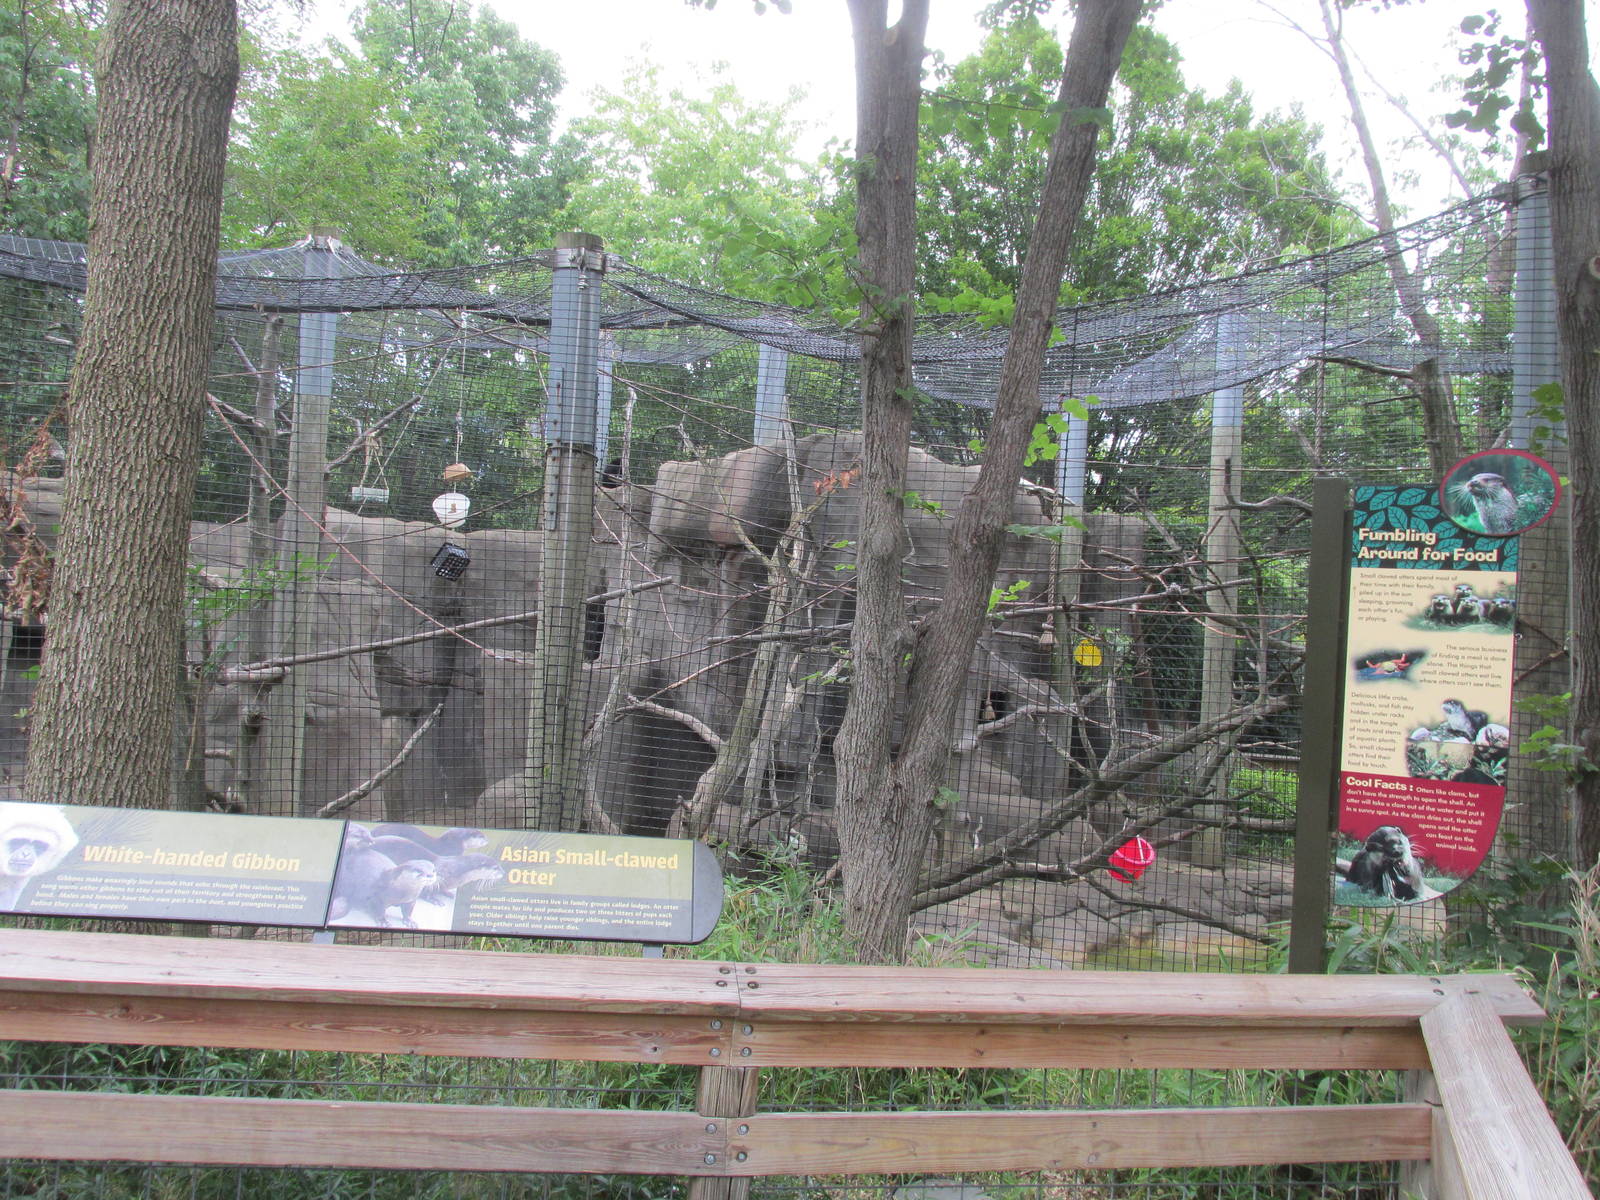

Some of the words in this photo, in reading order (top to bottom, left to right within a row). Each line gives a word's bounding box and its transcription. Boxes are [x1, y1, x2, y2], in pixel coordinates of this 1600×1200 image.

[1359, 528, 1436, 545] Fumbling
[1358, 546, 1418, 560] Around
[1422, 548, 1450, 560] for
[1453, 548, 1498, 562] Food
[1346, 776, 1371, 787] Cool
[1374, 779, 1406, 790] Facts
[1447, 789, 1467, 798] clams,
[1388, 793, 1412, 801] strength
[83, 845, 228, 868] White-handed
[232, 852, 300, 872] Gibbon
[500, 846, 549, 864] Asian
[555, 849, 678, 870] Small-clawed
[508, 868, 556, 886] Otter
[529, 914, 542, 922] help
[655, 919, 672, 927] lodge
